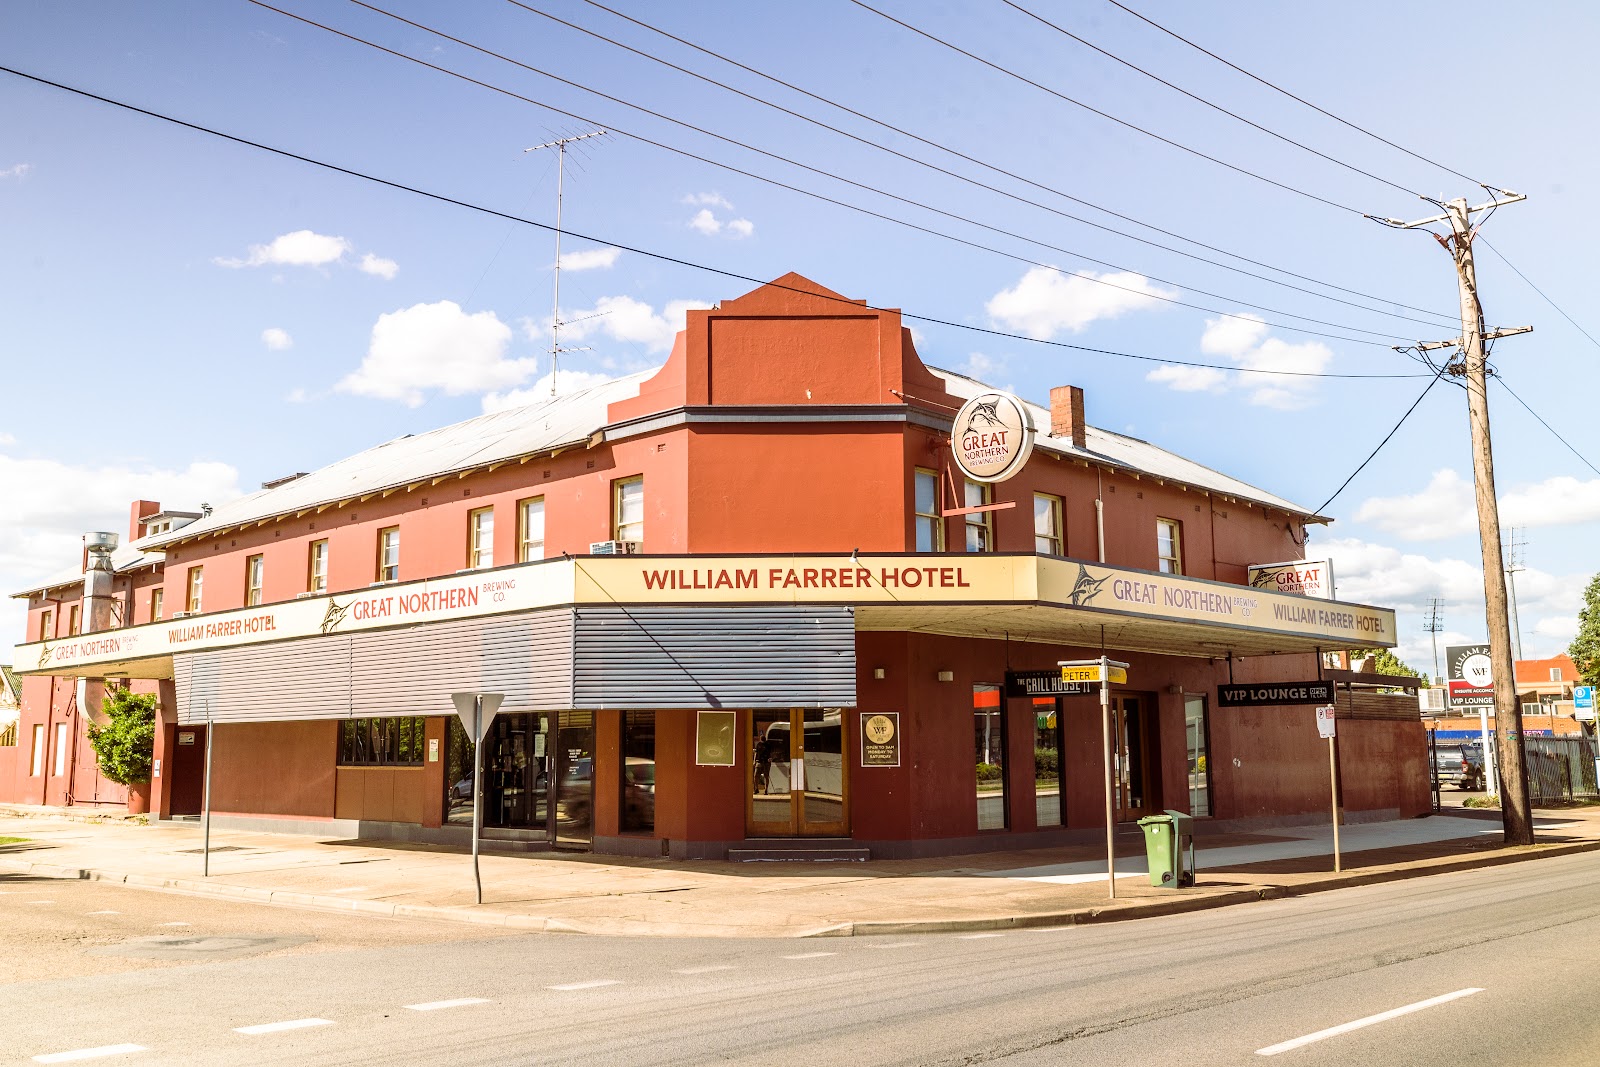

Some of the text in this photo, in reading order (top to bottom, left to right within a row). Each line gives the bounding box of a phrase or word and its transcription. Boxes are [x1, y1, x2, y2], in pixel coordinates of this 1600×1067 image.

[962, 430, 1009, 451] GREAT
[964, 446, 1009, 461] NORTHERN
[969, 457, 994, 467] BREWING
[642, 567, 971, 590] WILLIAM FARRER HOTEL
[1275, 568, 1321, 585] GREAT
[1277, 581, 1321, 593] NORTHERN
[352, 579, 516, 621] GREAT NORTHERN BREWING
[492, 592, 506, 603] CO.
[1112, 578, 1258, 615] GREAT NORTHERN BREWING
[1272, 602, 1385, 634] WILLIAM FARRER HOTEL
[167, 614, 277, 645] WILLIAM FARRER HOTEL
[55, 641, 77, 661] GREAT
[80, 636, 121, 656] NORTHERN
[1454, 646, 1480, 679] WILLIAM
[1063, 671, 1091, 681] PETER
[1471, 667, 1489, 676] WF
[1016, 678, 1026, 686] THE
[1026, 677, 1051, 692] GRILL
[1224, 690, 1247, 701] VIP
[1250, 687, 1308, 700] LOUNGE
[873, 726, 887, 735] WF
